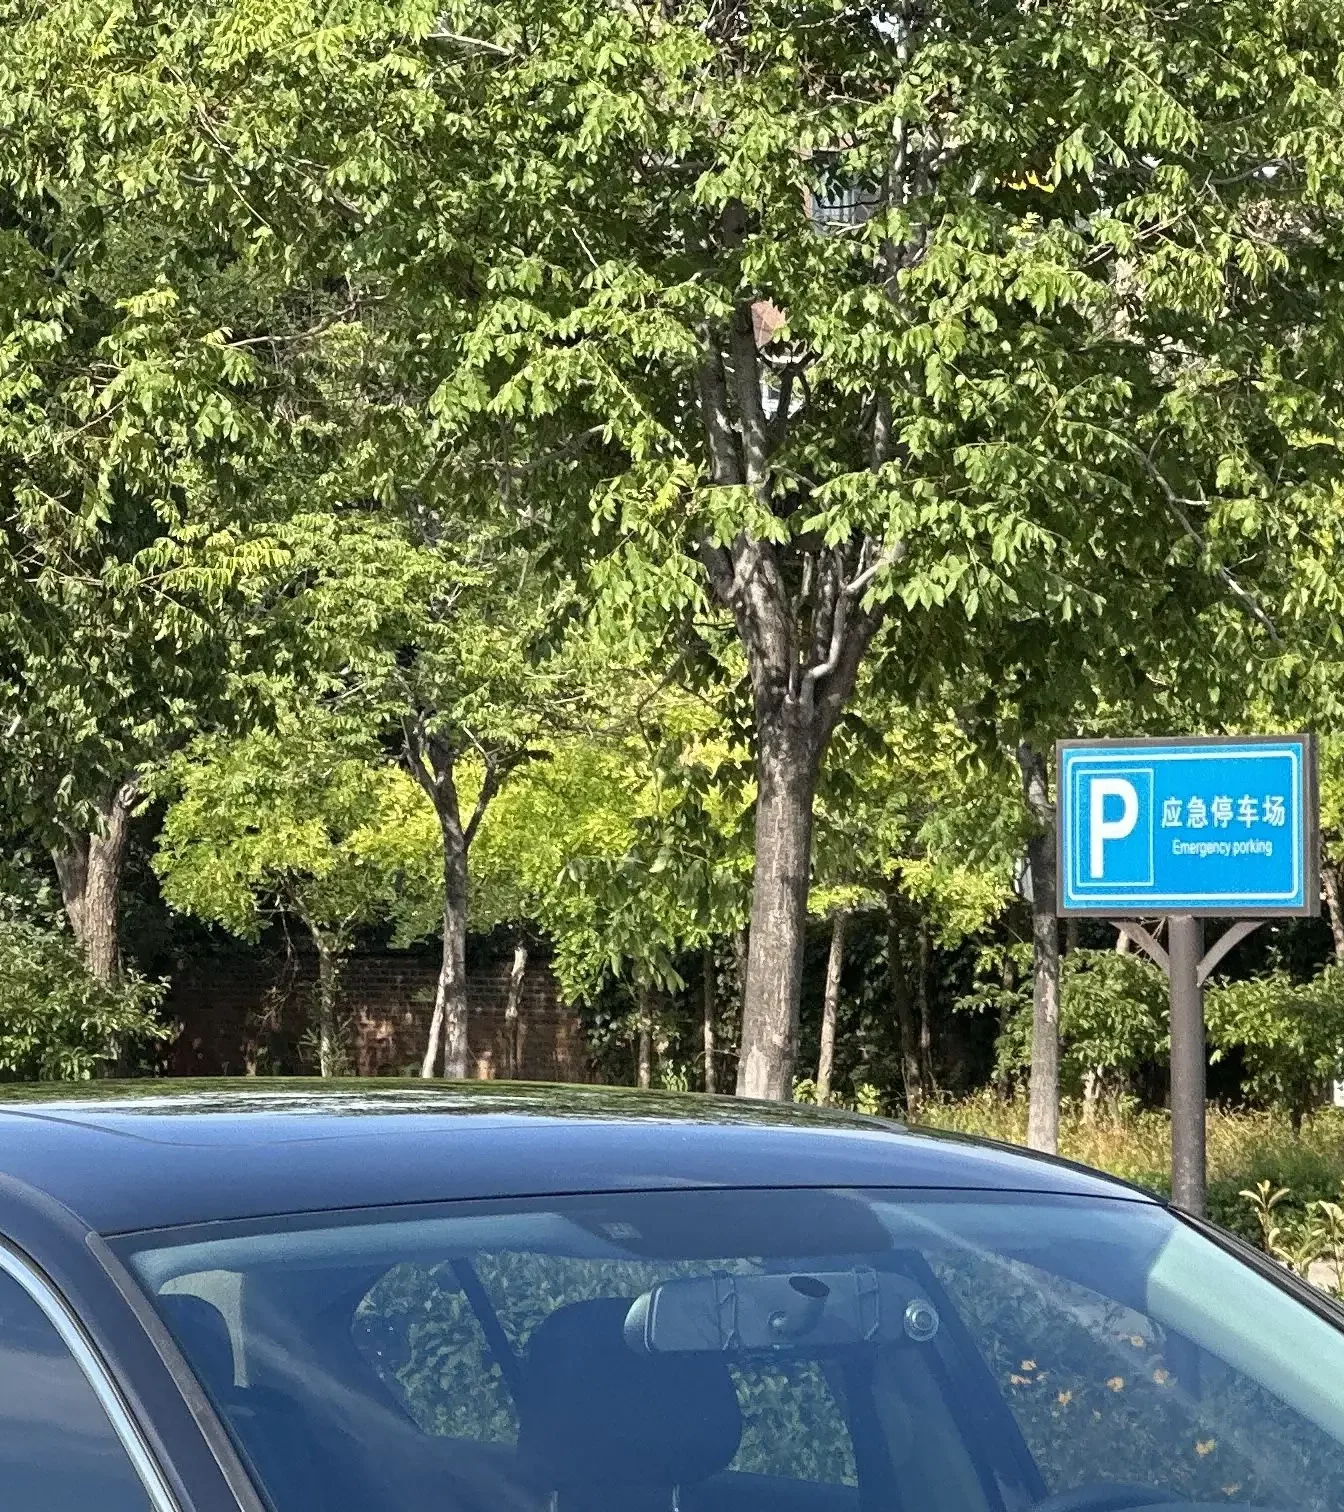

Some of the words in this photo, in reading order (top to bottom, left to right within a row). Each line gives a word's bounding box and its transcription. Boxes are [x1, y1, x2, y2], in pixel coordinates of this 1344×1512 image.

[1090, 778, 1139, 879] P
[1161, 794, 1286, 829] 应急停车场
[1172, 840, 1231, 858] Emergency
[1232, 839, 1273, 857] parking
